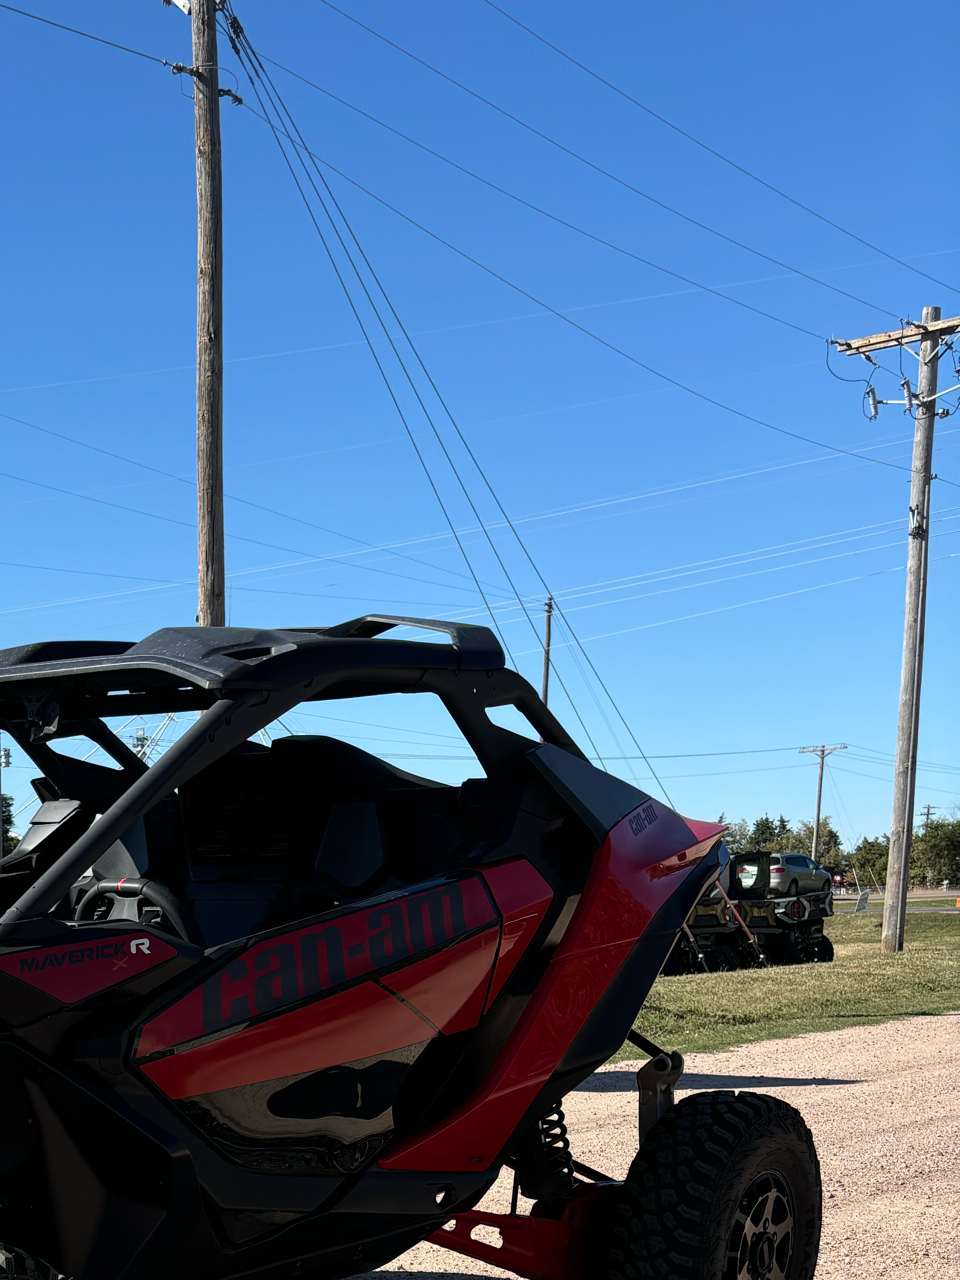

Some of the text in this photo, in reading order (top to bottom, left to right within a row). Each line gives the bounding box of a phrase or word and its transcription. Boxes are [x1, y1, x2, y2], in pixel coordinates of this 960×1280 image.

[628, 804, 658, 837] can-am
[19, 941, 127, 973] MAVERICK
[202, 884, 466, 1032] can-am
